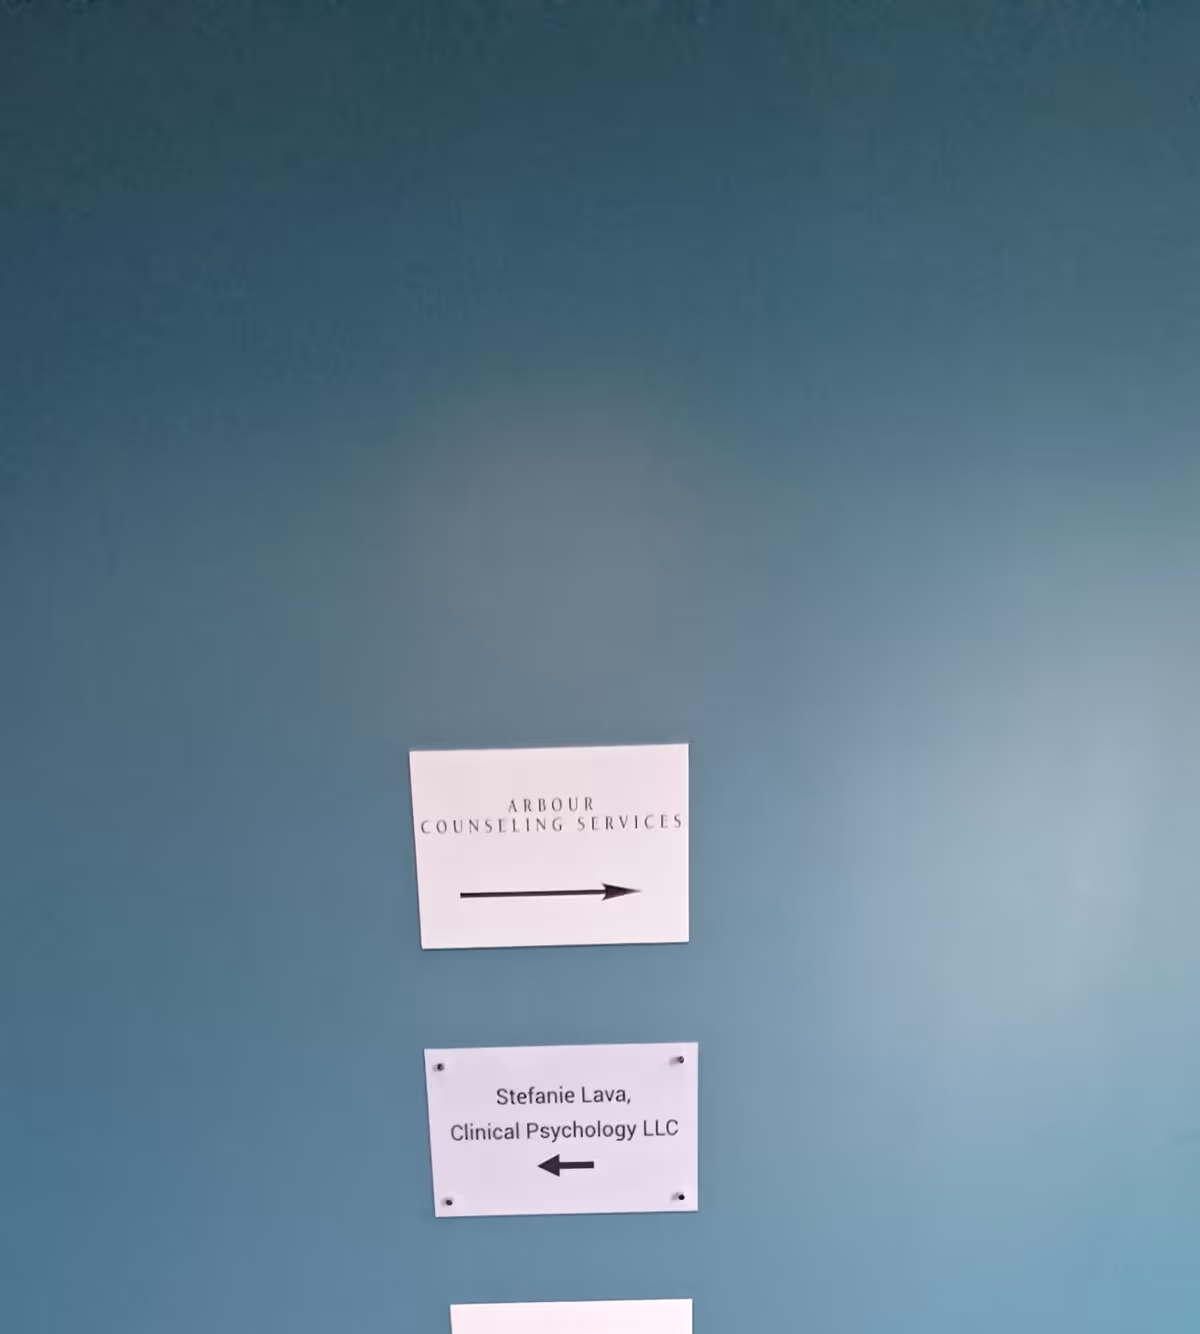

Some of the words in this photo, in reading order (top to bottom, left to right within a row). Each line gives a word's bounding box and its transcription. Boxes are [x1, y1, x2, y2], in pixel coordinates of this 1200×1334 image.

[507, 797, 594, 813] ARBOUR
[420, 818, 564, 834] COUNSELING
[577, 814, 683, 831] SERVICES
[496, 1086, 575, 1106] Stefanie
[581, 1086, 632, 1105] Lava,
[450, 1122, 520, 1142] Clinical
[526, 1120, 638, 1143] Psychology
[643, 1119, 680, 1137] LLC
